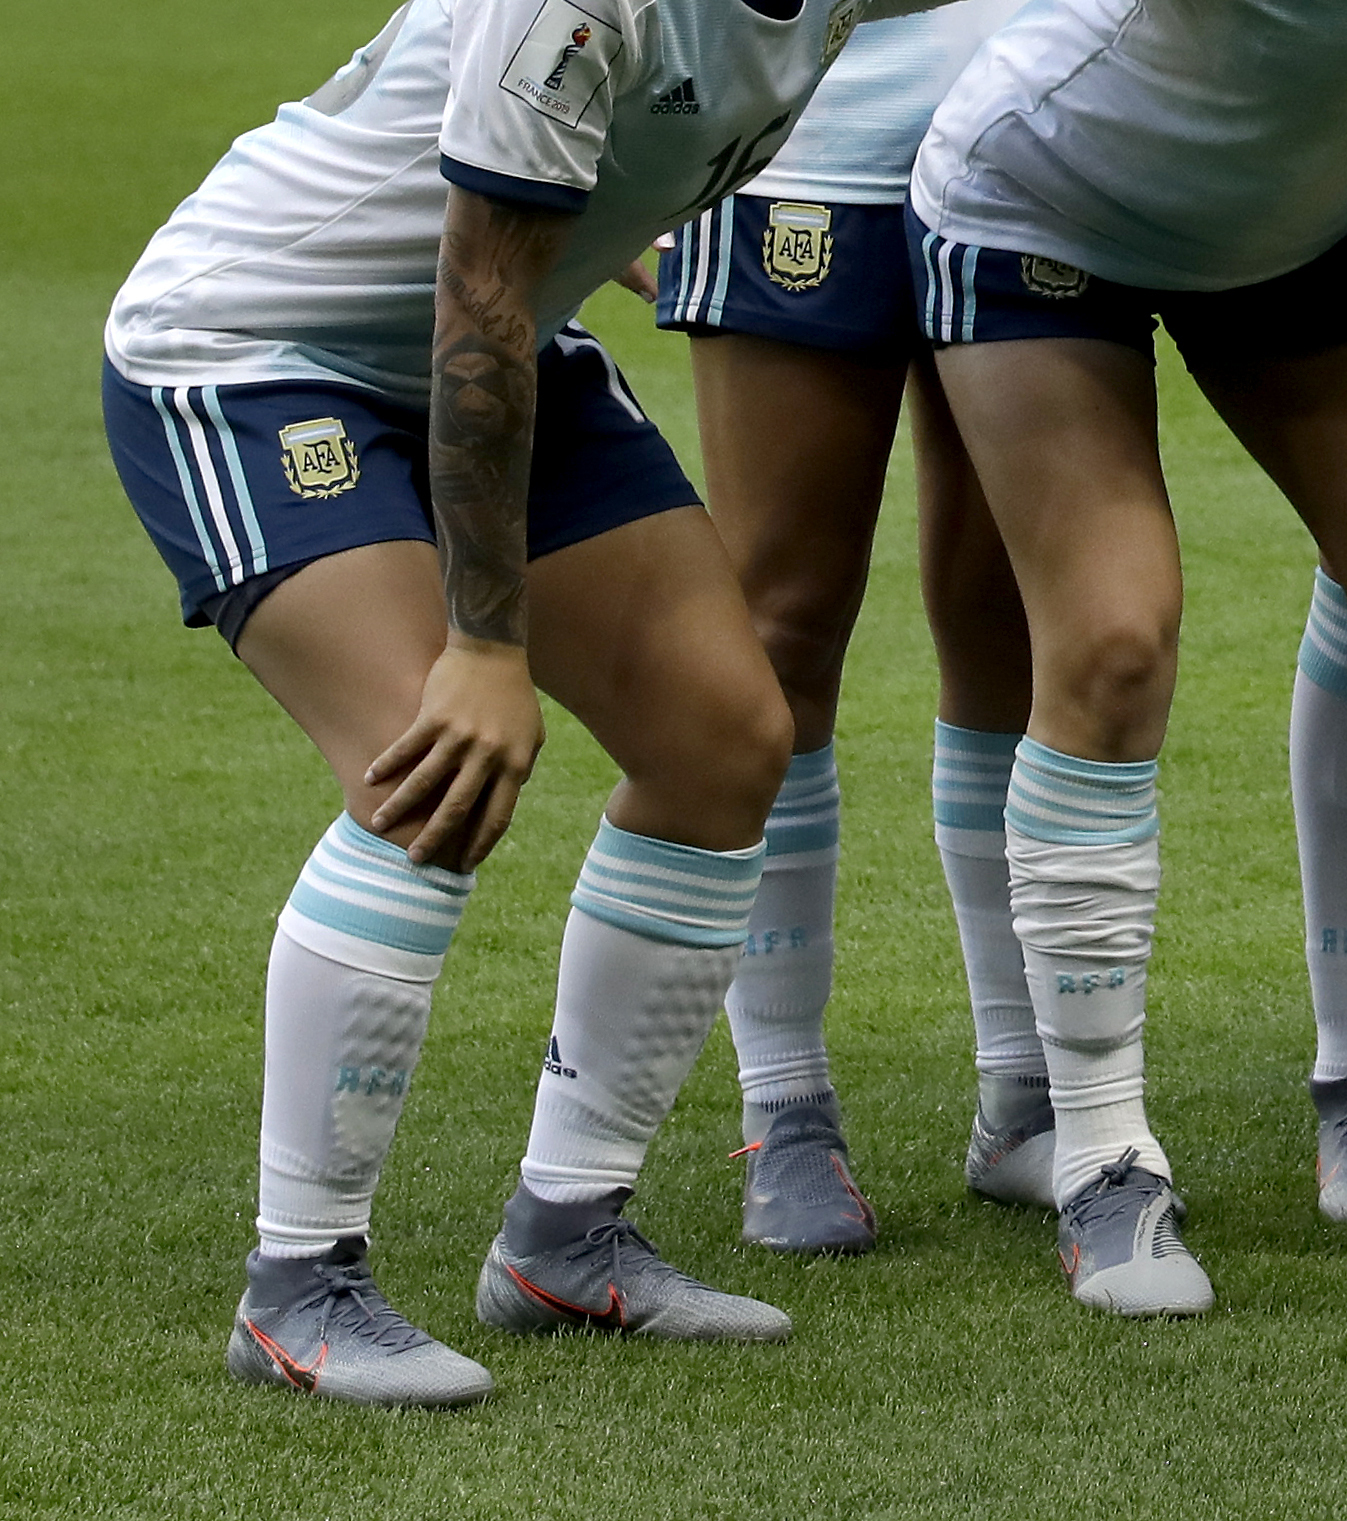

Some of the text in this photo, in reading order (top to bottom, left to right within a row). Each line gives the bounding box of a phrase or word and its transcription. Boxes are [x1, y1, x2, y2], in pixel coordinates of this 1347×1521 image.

[517, 78, 571, 115] FRANCE 2019
[650, 101, 700, 115] adidas
[778, 228, 817, 266] AFA
[302, 438, 342, 475] AFA
